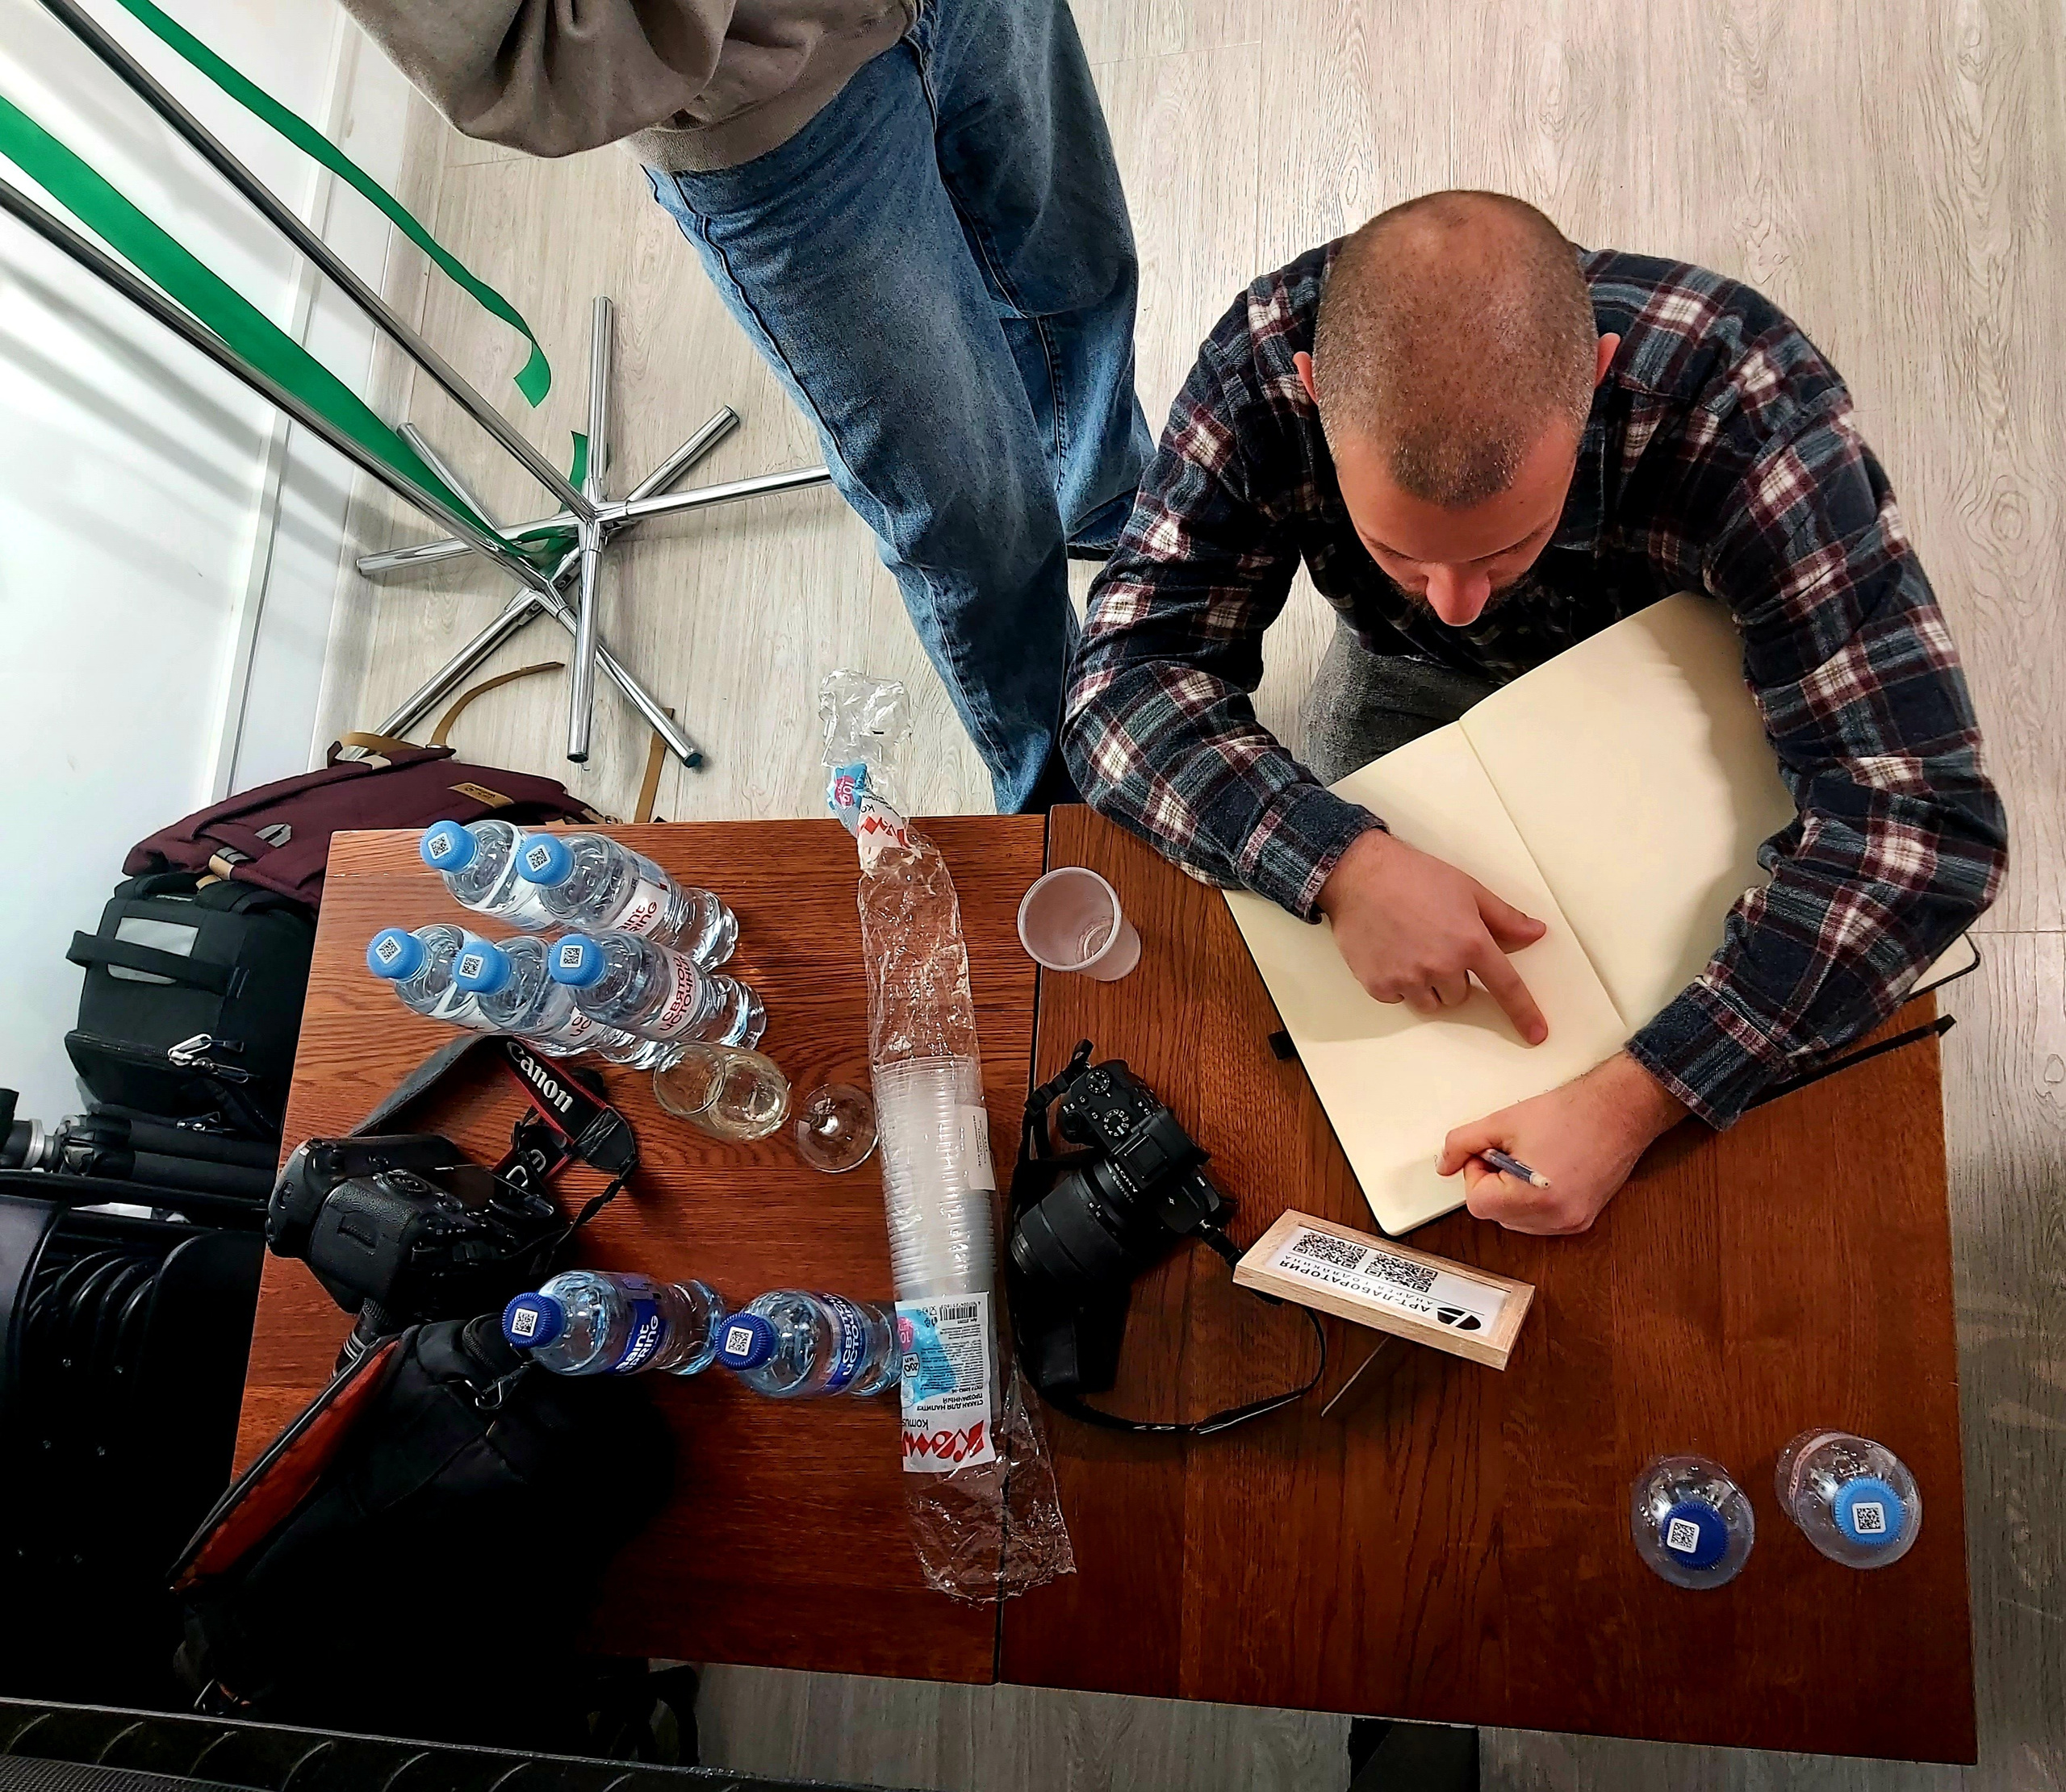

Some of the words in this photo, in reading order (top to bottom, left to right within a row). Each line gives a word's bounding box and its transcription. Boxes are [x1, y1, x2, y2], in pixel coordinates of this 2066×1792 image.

[615, 904, 646, 930] aint
[628, 901, 658, 933] RING
[662, 956, 684, 1022] СВЯТОЙ
[506, 1041, 574, 1113] Canon
[1114, 1163, 1138, 1193] SONY
[1279, 1260, 1431, 1313] АРТ-ЛАБОРАТОРИЯ
